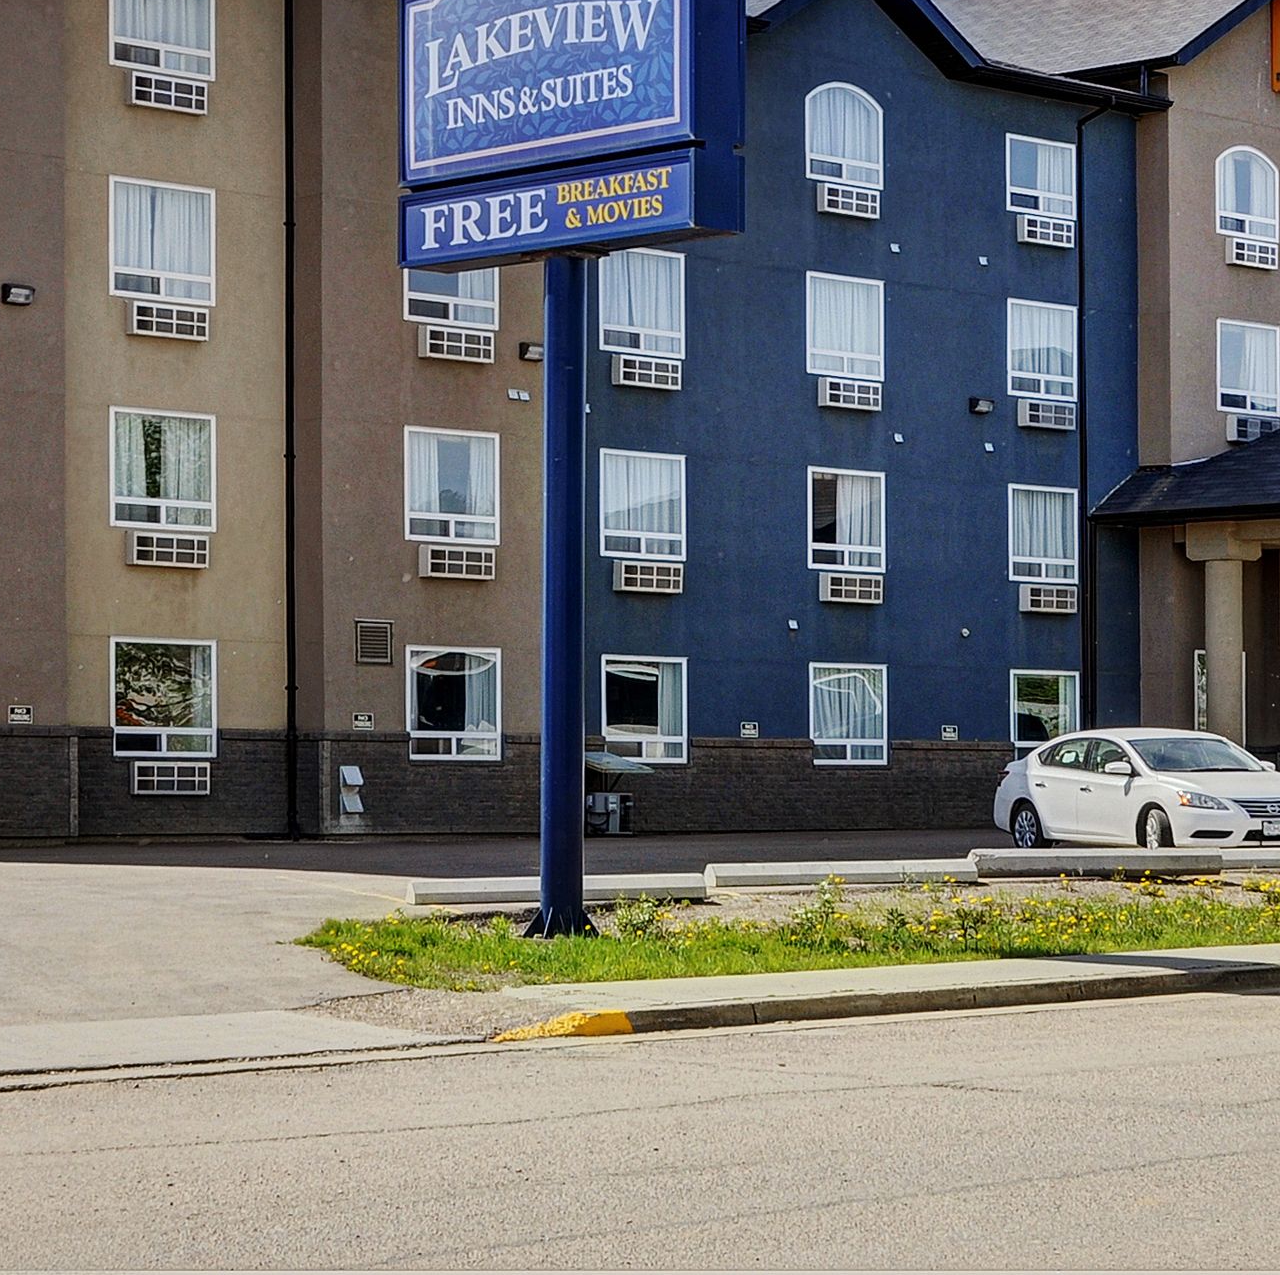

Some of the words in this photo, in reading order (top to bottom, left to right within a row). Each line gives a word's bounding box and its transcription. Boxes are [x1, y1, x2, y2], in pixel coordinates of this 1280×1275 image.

[556, 166, 672, 205] BREAKFAST
[421, 188, 548, 250] FREE
[565, 208, 582, 229] &
[586, 194, 663, 227] MOVIES
